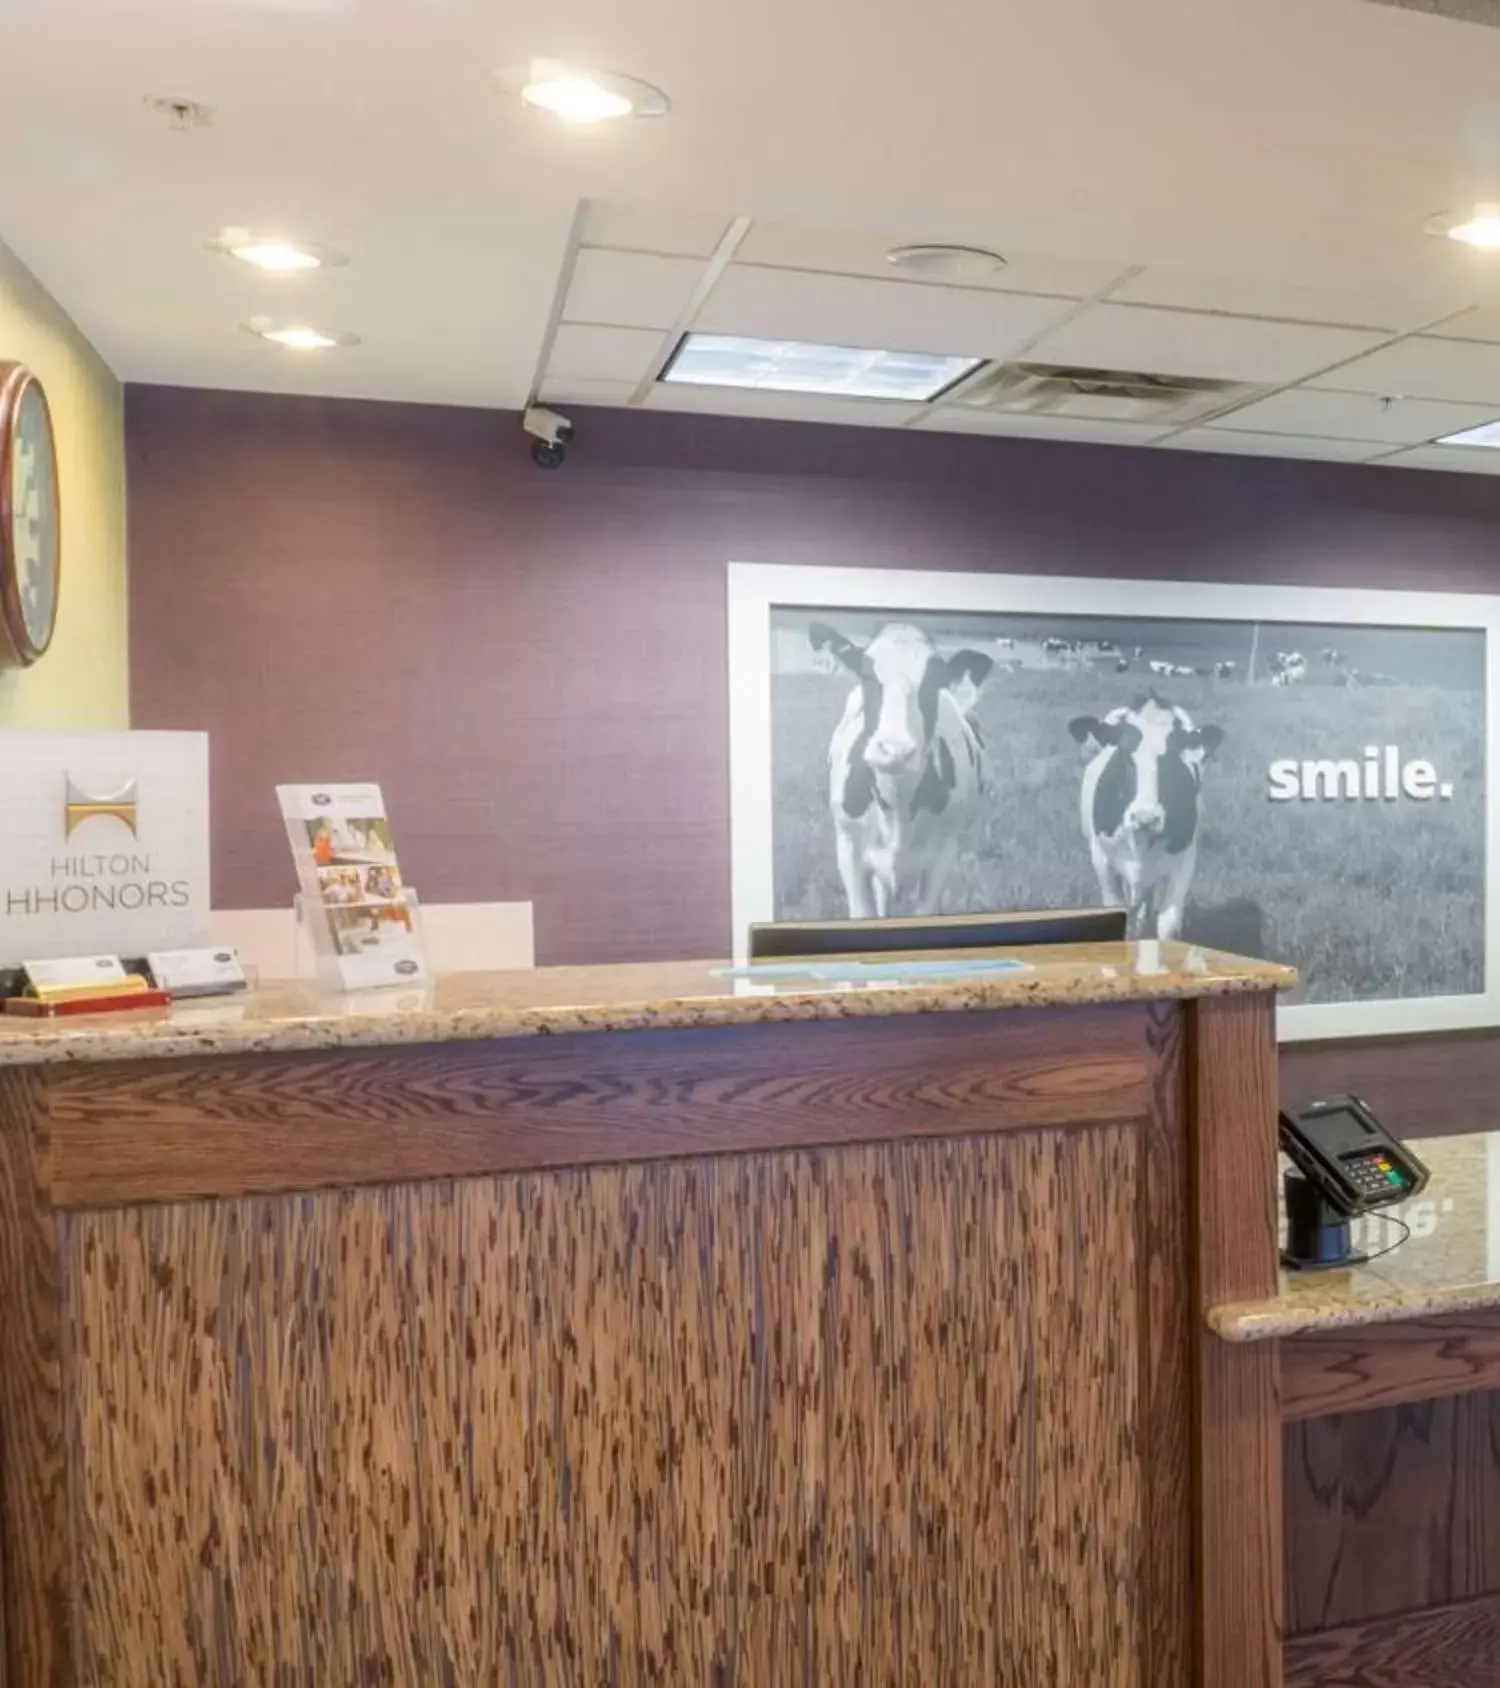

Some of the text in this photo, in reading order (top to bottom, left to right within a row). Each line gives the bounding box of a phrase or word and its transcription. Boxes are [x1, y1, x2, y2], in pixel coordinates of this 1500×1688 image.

[1268, 745, 1453, 800] smile.
[51, 854, 150, 877] HILTON
[7, 880, 190, 915] HHONORS
